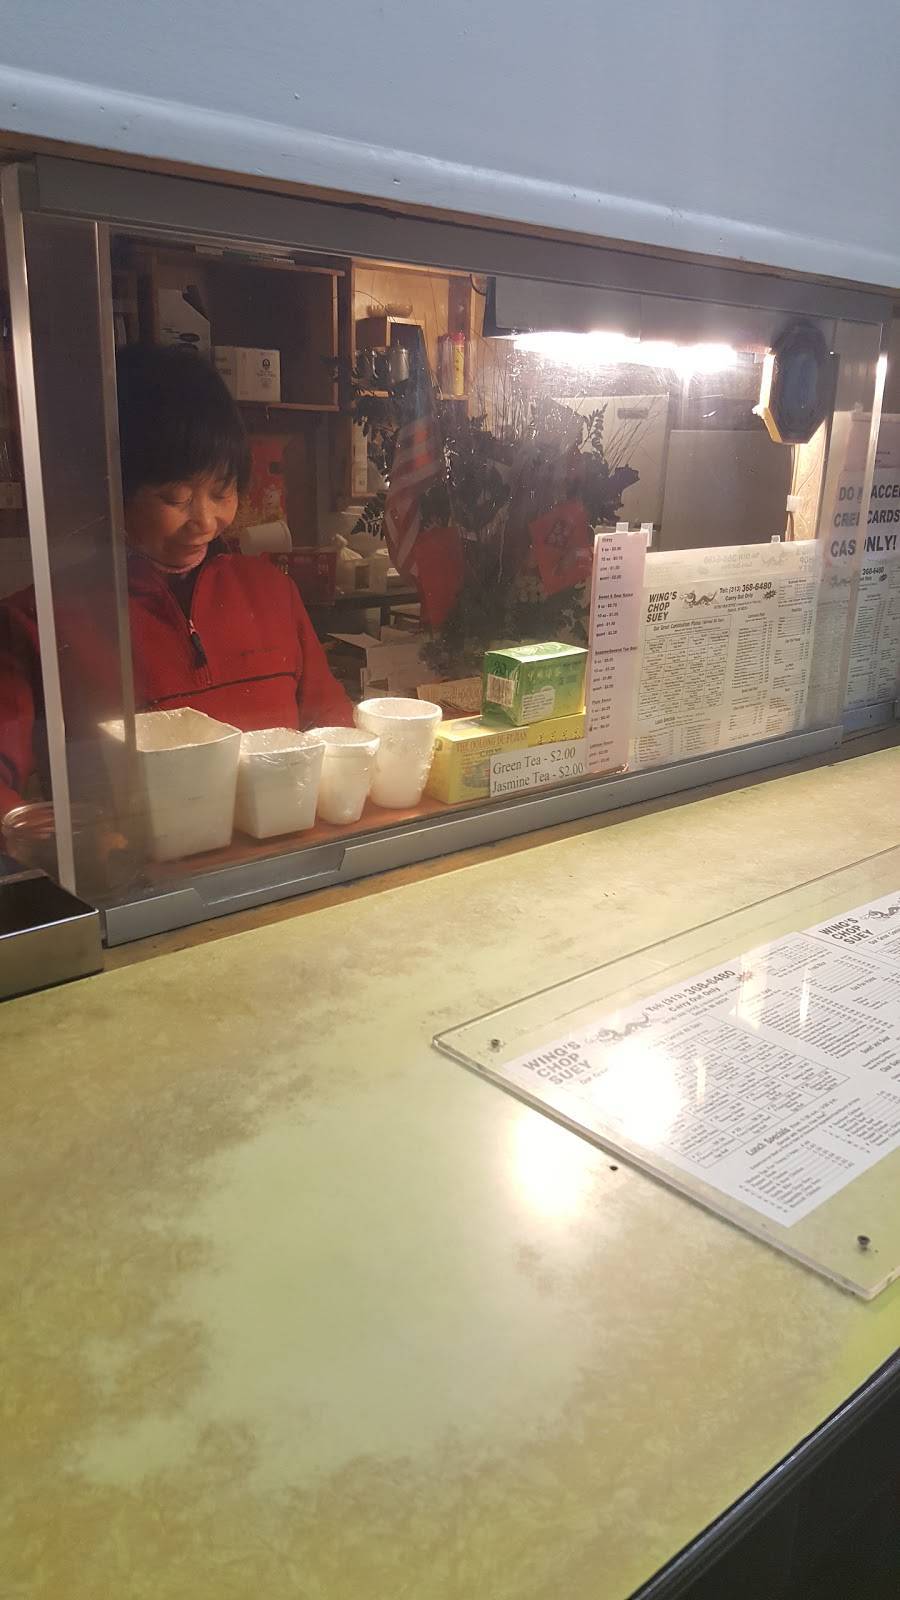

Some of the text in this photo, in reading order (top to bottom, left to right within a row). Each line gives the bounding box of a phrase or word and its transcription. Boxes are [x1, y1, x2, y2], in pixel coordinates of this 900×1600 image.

[838, 486, 855, 501] DO
[830, 539, 857, 557] CAS
[742, 582, 772, 593] 368-6480
[649, 591, 678, 603] WING'S
[647, 602, 670, 613] CHOP
[646, 611, 669, 623] SUEY
[492, 759, 522, 775] Green
[524, 755, 541, 768] Tea
[550, 746, 576, 763] $2.00
[491, 775, 530, 794] Jasmine
[532, 770, 550, 784] Tea
[558, 761, 584, 779] $2.00
[818, 917, 859, 935] WING'S
[831, 925, 861, 940] CHOP
[843, 929, 874, 945] SUEY
[684, 970, 736, 995] 368-6480
[522, 1041, 581, 1071] WING'S
[536, 1052, 580, 1078] CHOP
[548, 1059, 592, 1085] SUEY
